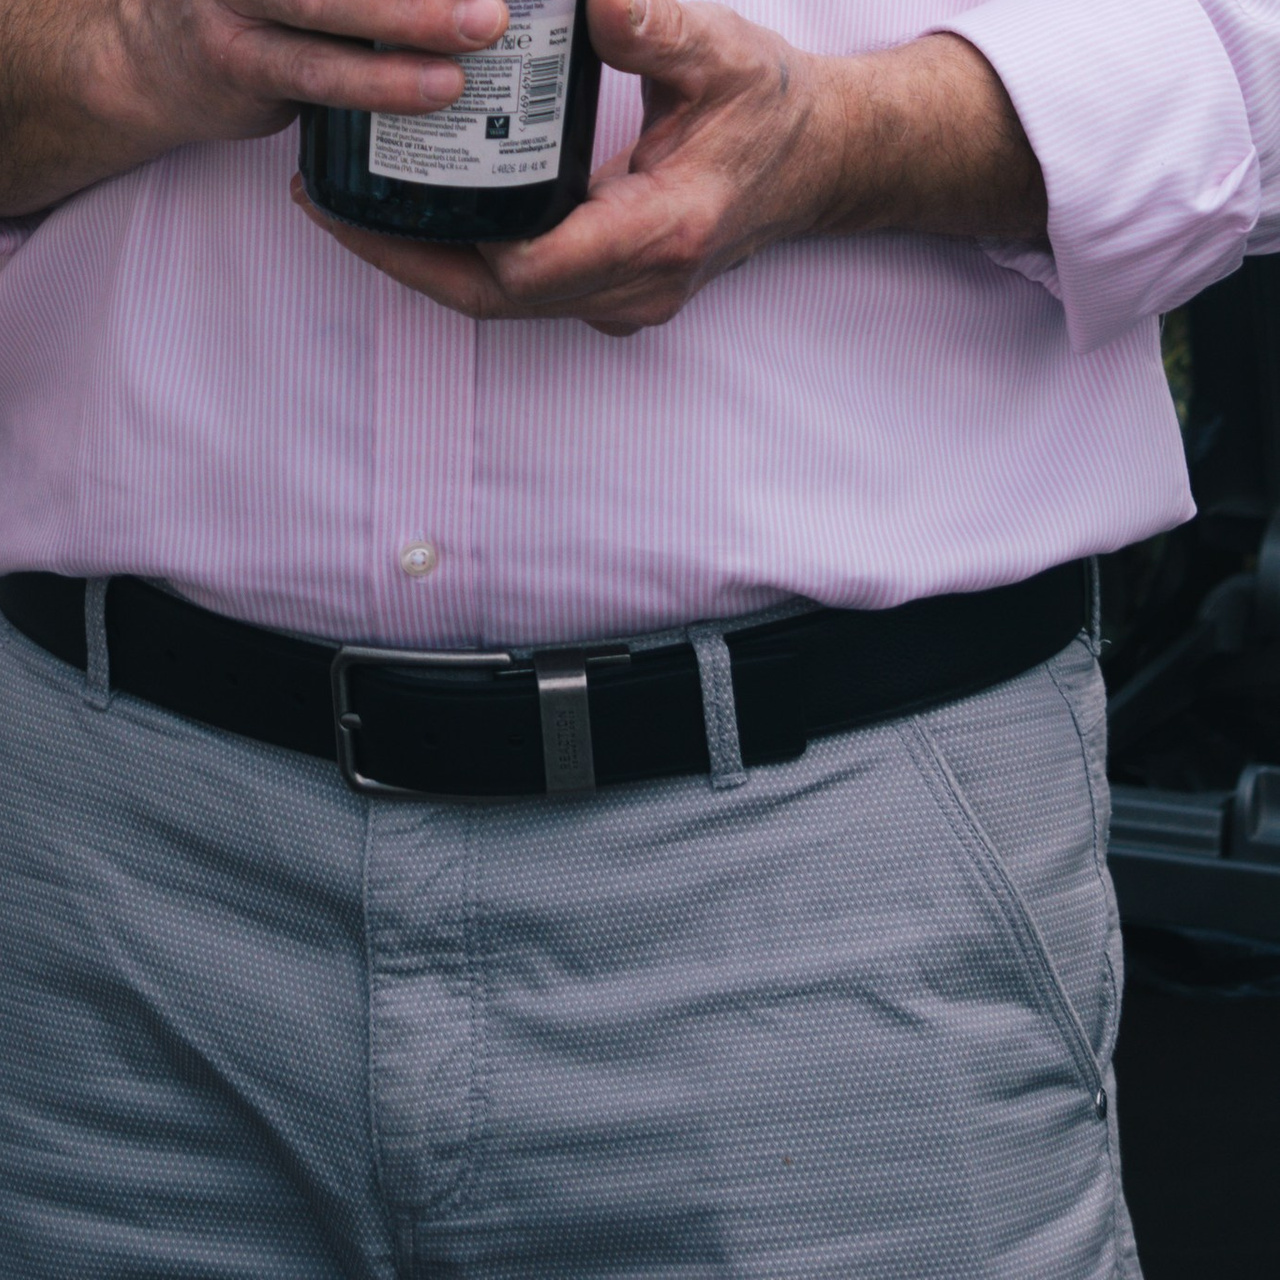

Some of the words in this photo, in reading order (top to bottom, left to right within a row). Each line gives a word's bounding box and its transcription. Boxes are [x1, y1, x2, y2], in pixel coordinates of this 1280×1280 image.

[376, 135, 403, 147] PRODUCE
[405, 141, 412, 149] OF
[414, 143, 433, 152] ITALY
[406, 150, 445, 161] Supermarkets
